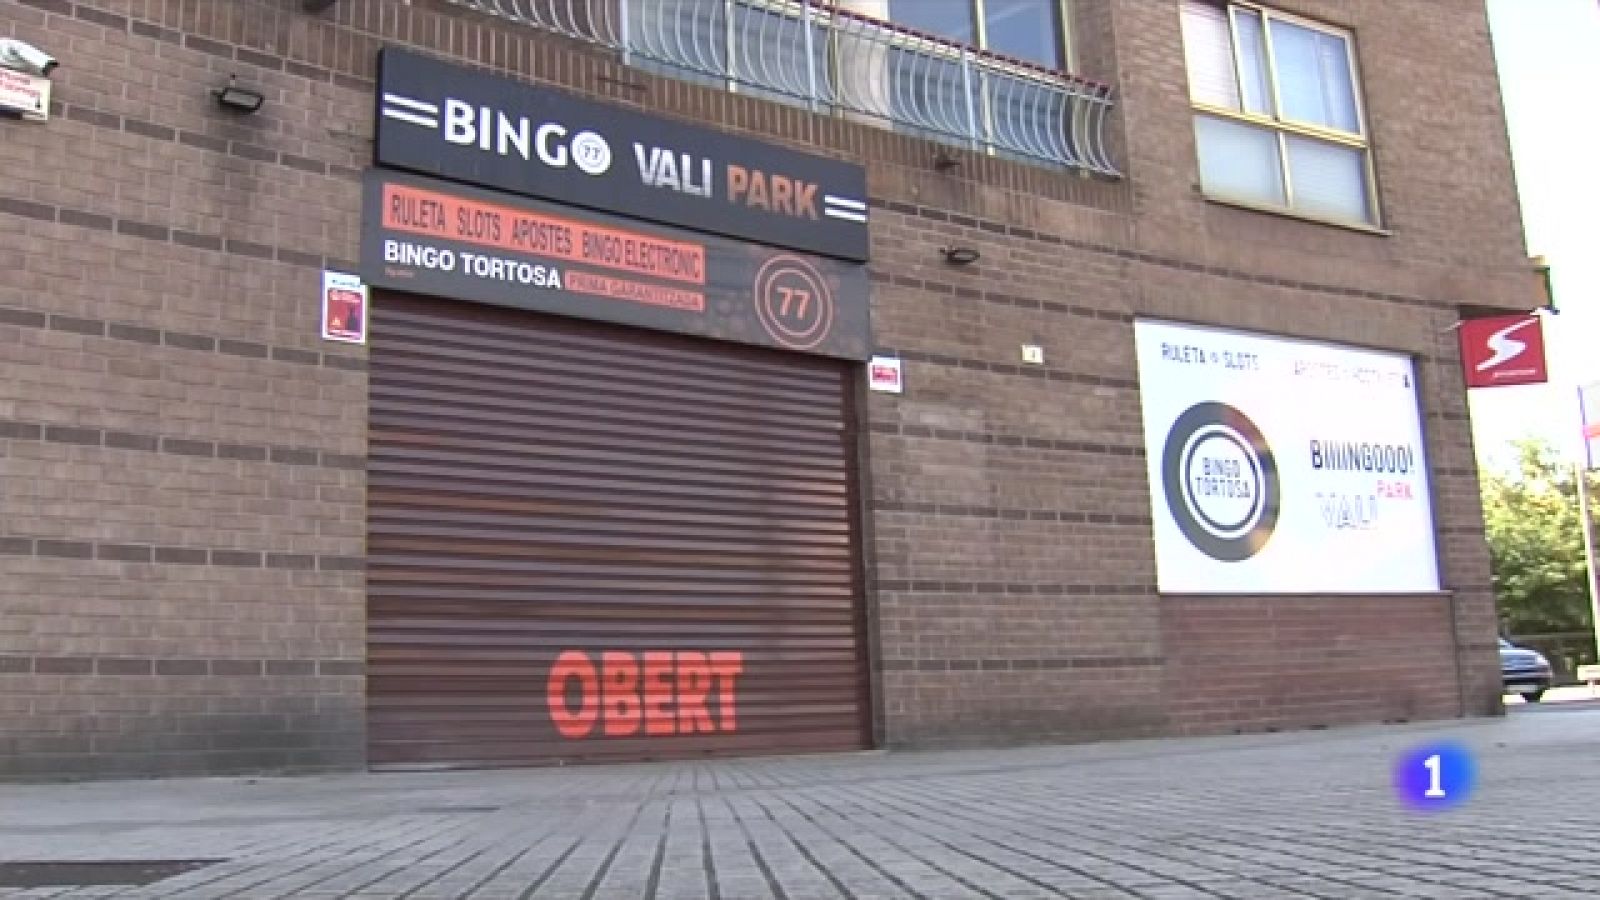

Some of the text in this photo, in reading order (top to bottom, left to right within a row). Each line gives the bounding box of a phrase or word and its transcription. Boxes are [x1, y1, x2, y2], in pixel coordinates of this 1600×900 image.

[444, 98, 819, 221] BINGO VALI PARK
[391, 194, 701, 279] RULETA SLOTS APOSTES BINGO ELECTRONIC
[384, 239, 561, 289] BINGO TORTOSA
[776, 287, 811, 321] 77
[1161, 342, 1260, 371] RULETA SLOTS
[1195, 476, 1251, 499] TORTOSA
[1202, 457, 1241, 479] BINGO
[547, 649, 743, 739] OBERT
